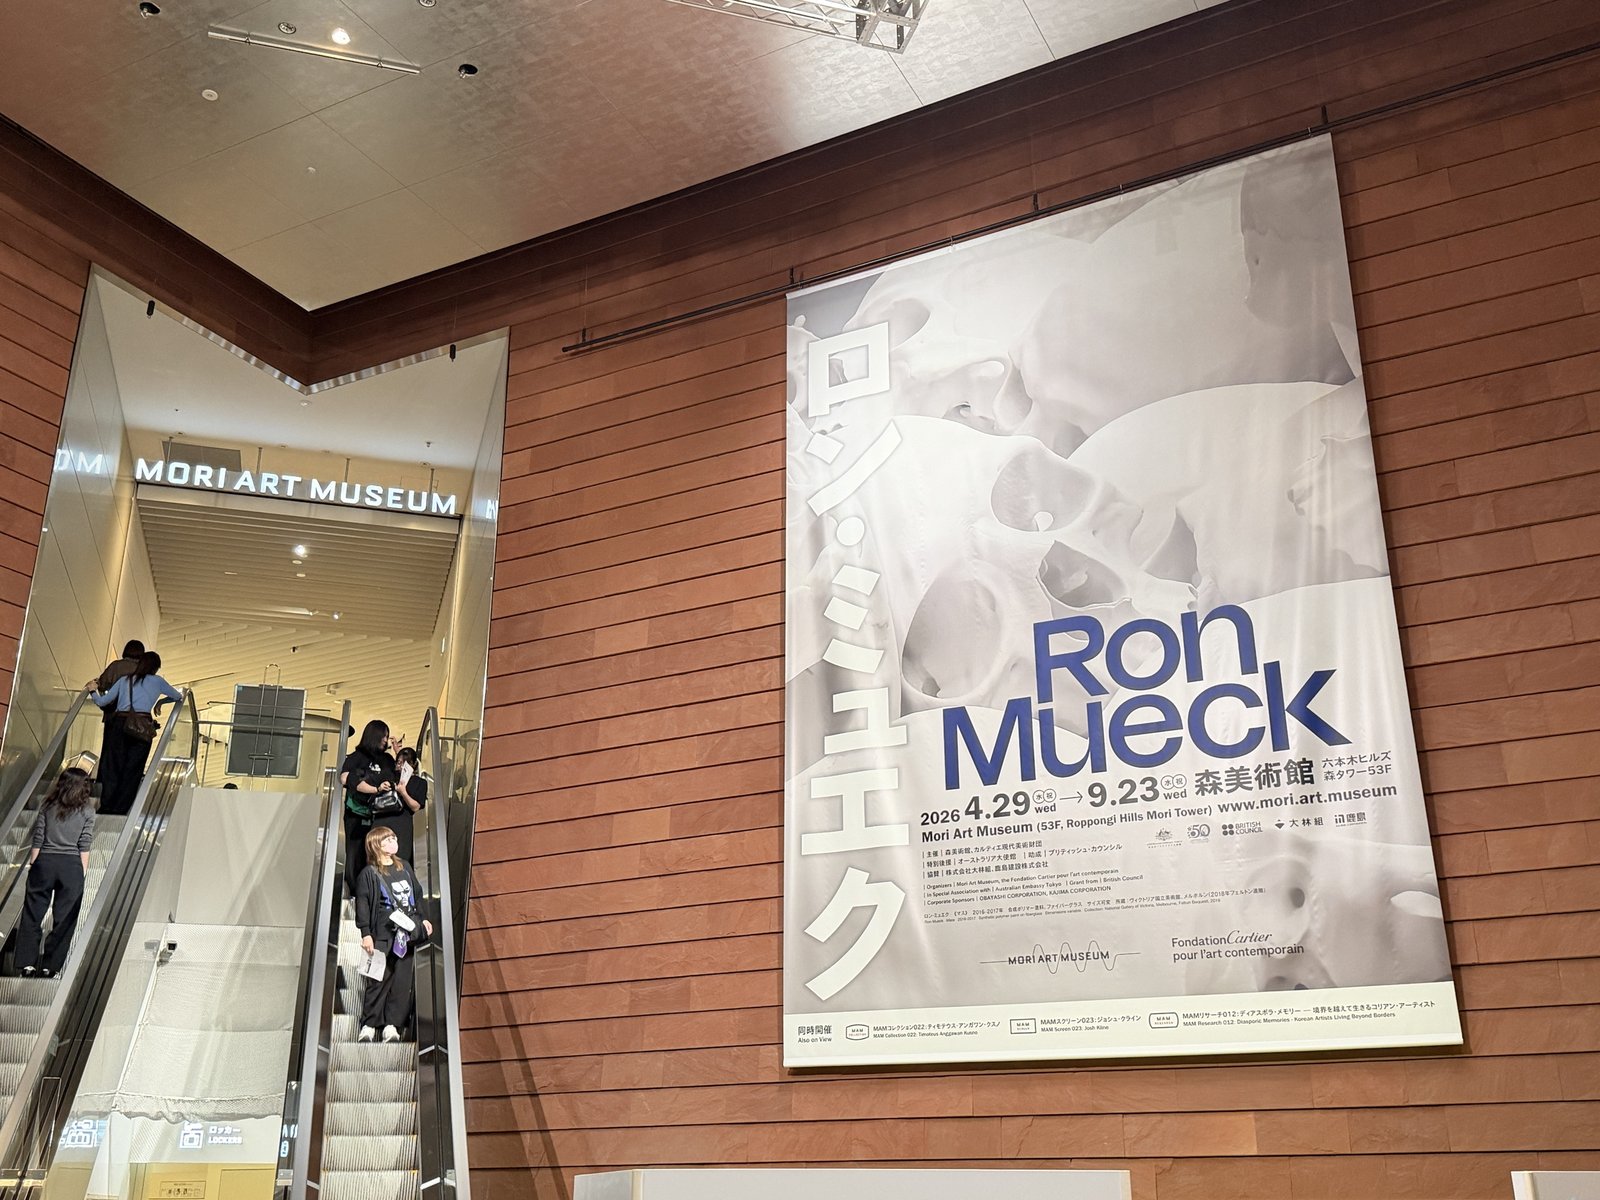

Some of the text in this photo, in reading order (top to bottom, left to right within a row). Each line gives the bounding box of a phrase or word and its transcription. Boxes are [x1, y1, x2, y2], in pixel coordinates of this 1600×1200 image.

[135, 458, 227, 489] MORI
[233, 470, 302, 497] ART
[310, 478, 457, 515] MUSEUM
[1032, 603, 1259, 704] Ron
[941, 660, 1353, 791] Mueck
[1321, 750, 1391, 769] 六本木ヒルズ
[1195, 757, 1314, 797] 森美術館
[1323, 764, 1392, 782] 森タワー53F
[920, 809, 961, 826] 2026
[964, 791, 1031, 820] 4.29
[1088, 776, 1160, 808] 9.23
[1163, 789, 1188, 800] wed
[922, 786, 1397, 842] Mori Art Museum (53F, Roppongi Hills Mori Tower) www.mori.art.museum
[1034, 803, 1057, 814] wed
[1235, 820, 1262, 830] BRITISH
[1235, 826, 1264, 835] COUNCIL
[1081, 868, 1119, 877] contemporain
[932, 890, 950, 898] Special
[995, 884, 1021, 892] Australian
[979, 893, 1006, 901] OBAYASHI
[1070, 885, 1112, 894] CORPORATION
[1008, 951, 1110, 966] MORI ART MUSEUM
[1173, 951, 1199, 962] pour
[1224, 944, 1304, 958] contemporain
[208, 1125, 241, 1134] ロッカー
